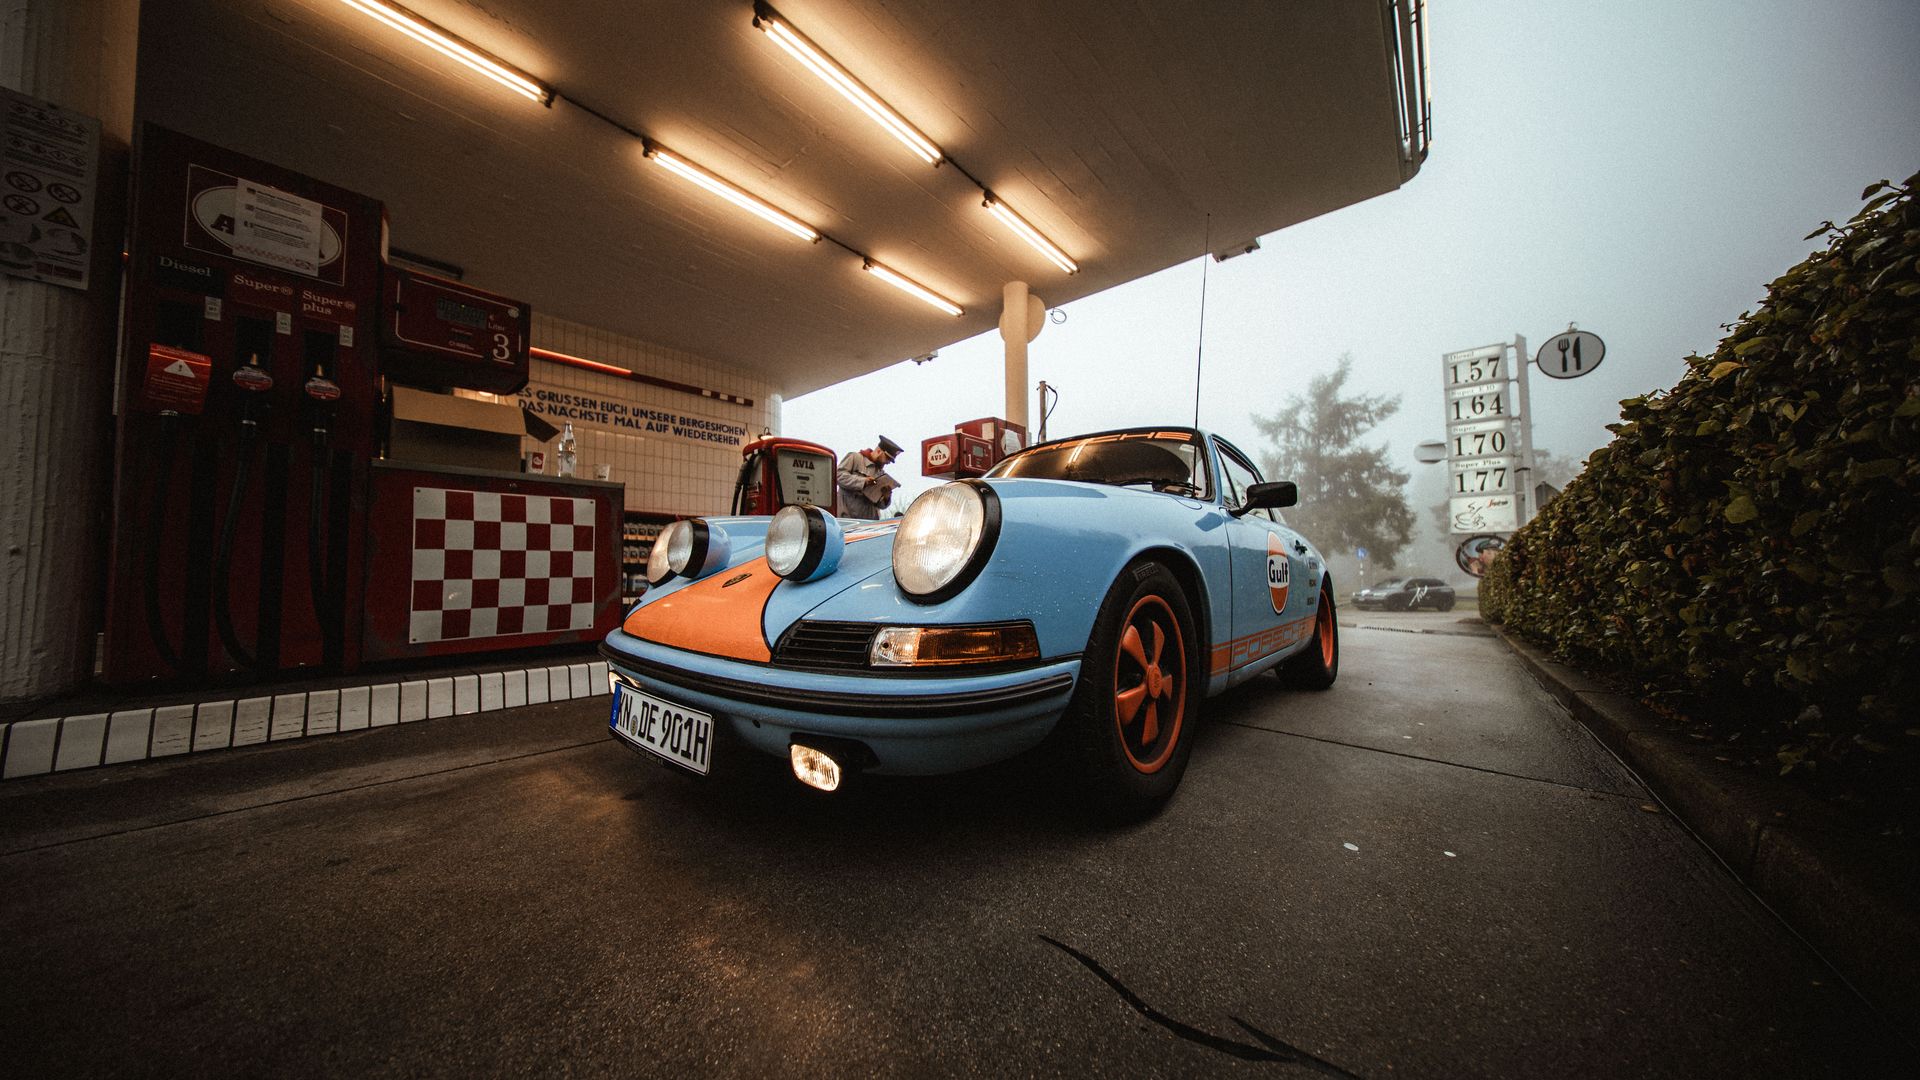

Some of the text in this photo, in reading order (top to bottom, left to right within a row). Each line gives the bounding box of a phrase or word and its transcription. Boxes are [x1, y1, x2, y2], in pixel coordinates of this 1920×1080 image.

[159, 256, 212, 277] Diesel
[233, 273, 281, 295] Super
[302, 290, 343, 309] Super
[302, 303, 332, 315] plus
[493, 333, 511, 360] 3
[1450, 356, 1501, 384] 1.57
[600, 401, 628, 416] EUCH
[632, 407, 677, 425] UNSERE
[1452, 393, 1504, 420] 1.64
[518, 399, 545, 414] DAS
[614, 415, 642, 430] MAL
[646, 421, 669, 434] AUF
[672, 426, 740, 446] WIEDERSEHEN
[1454, 431, 1506, 456] 1.70
[792, 458, 815, 470] AVIA
[930, 453, 947, 461] AVIA
[967, 453, 973, 468] 1
[1456, 468, 1507, 493] 1.77
[1268, 559, 1288, 583] Gulf
[1232, 622, 1307, 666] PORSCHE
[638, 701, 659, 745] DE
[660, 710, 709, 766] 901H
